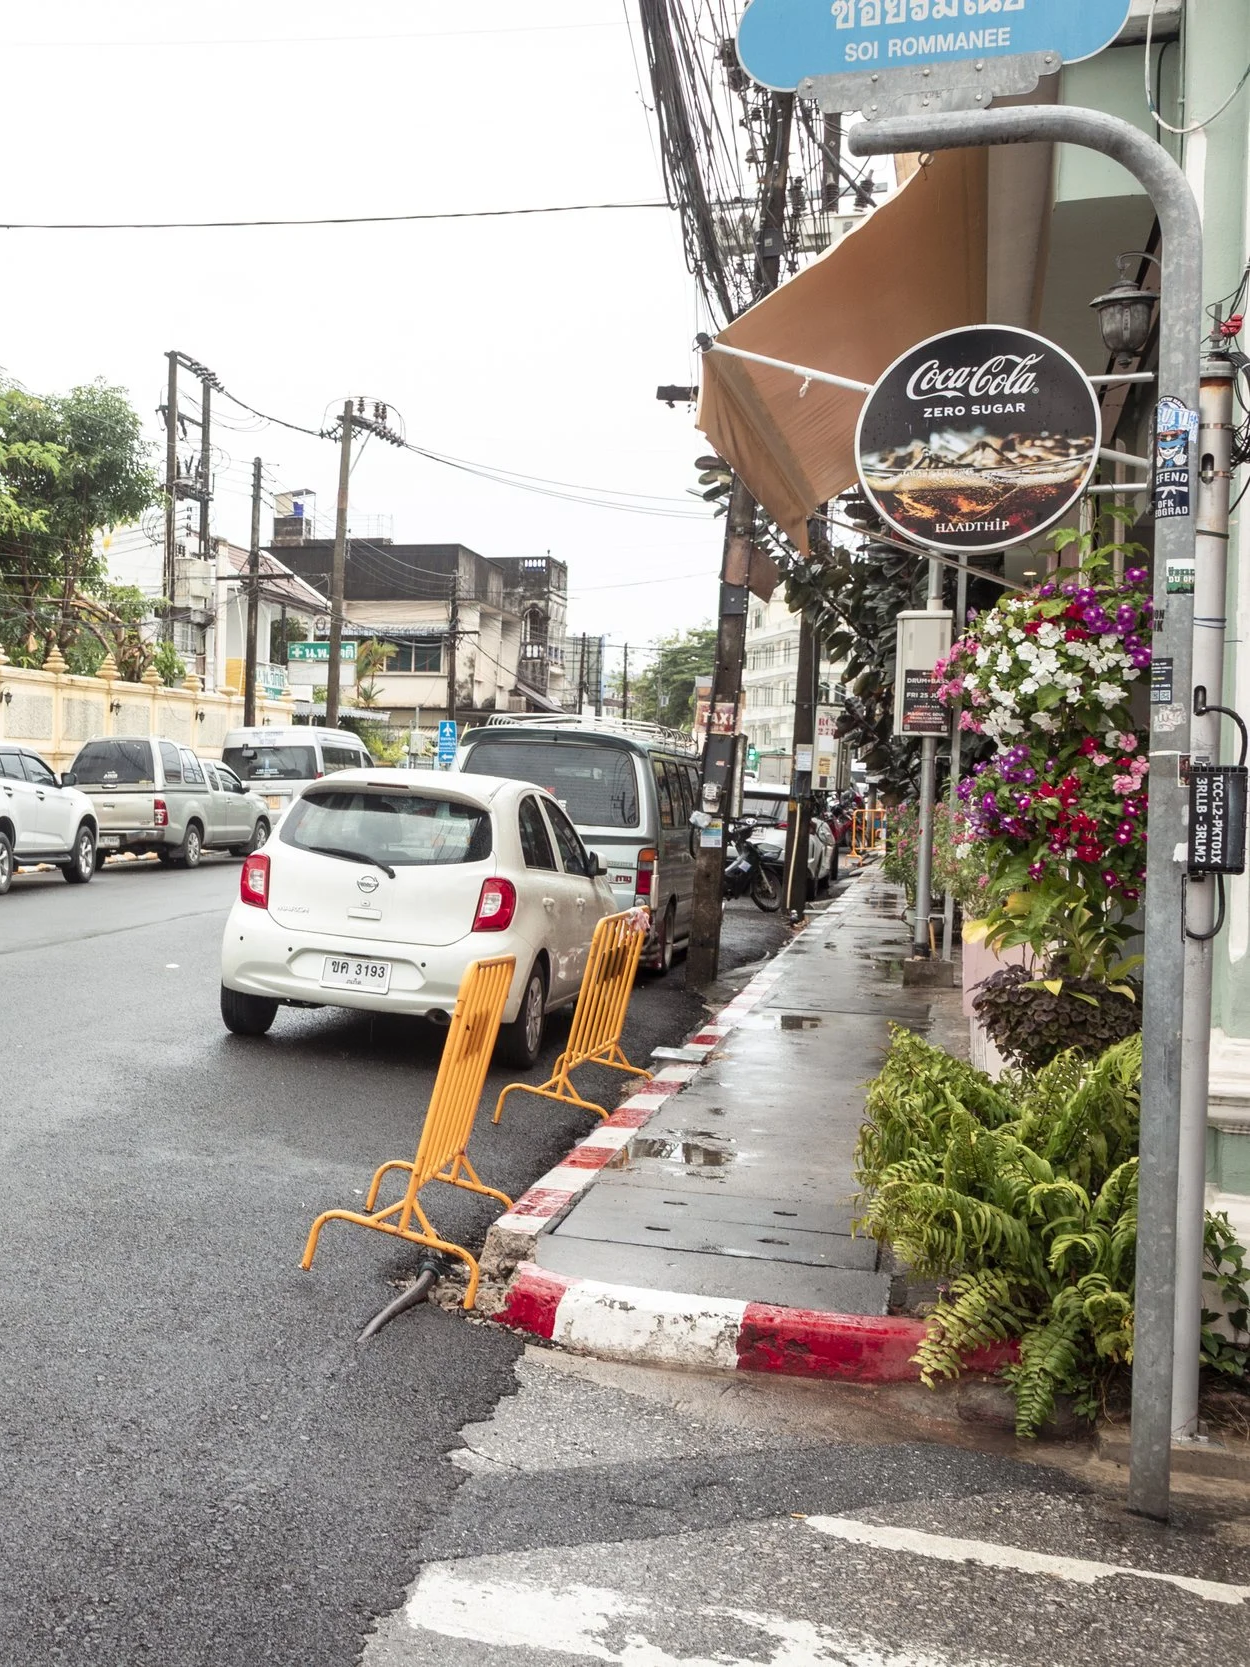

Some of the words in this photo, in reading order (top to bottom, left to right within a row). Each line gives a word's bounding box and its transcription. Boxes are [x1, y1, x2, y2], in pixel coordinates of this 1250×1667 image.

[845, 41, 878, 62] SOI
[888, 27, 1011, 57] ROMMANEE
[906, 353, 1044, 400] Coca-Cola
[923, 407, 966, 418] ZERO
[971, 402, 1026, 415] SUGAR
[1156, 471, 1188, 485] EFEND
[702, 711, 735, 726] TAXI
[1195, 824, 1207, 863] 3RLM2
[355, 964, 385, 978] 3193
